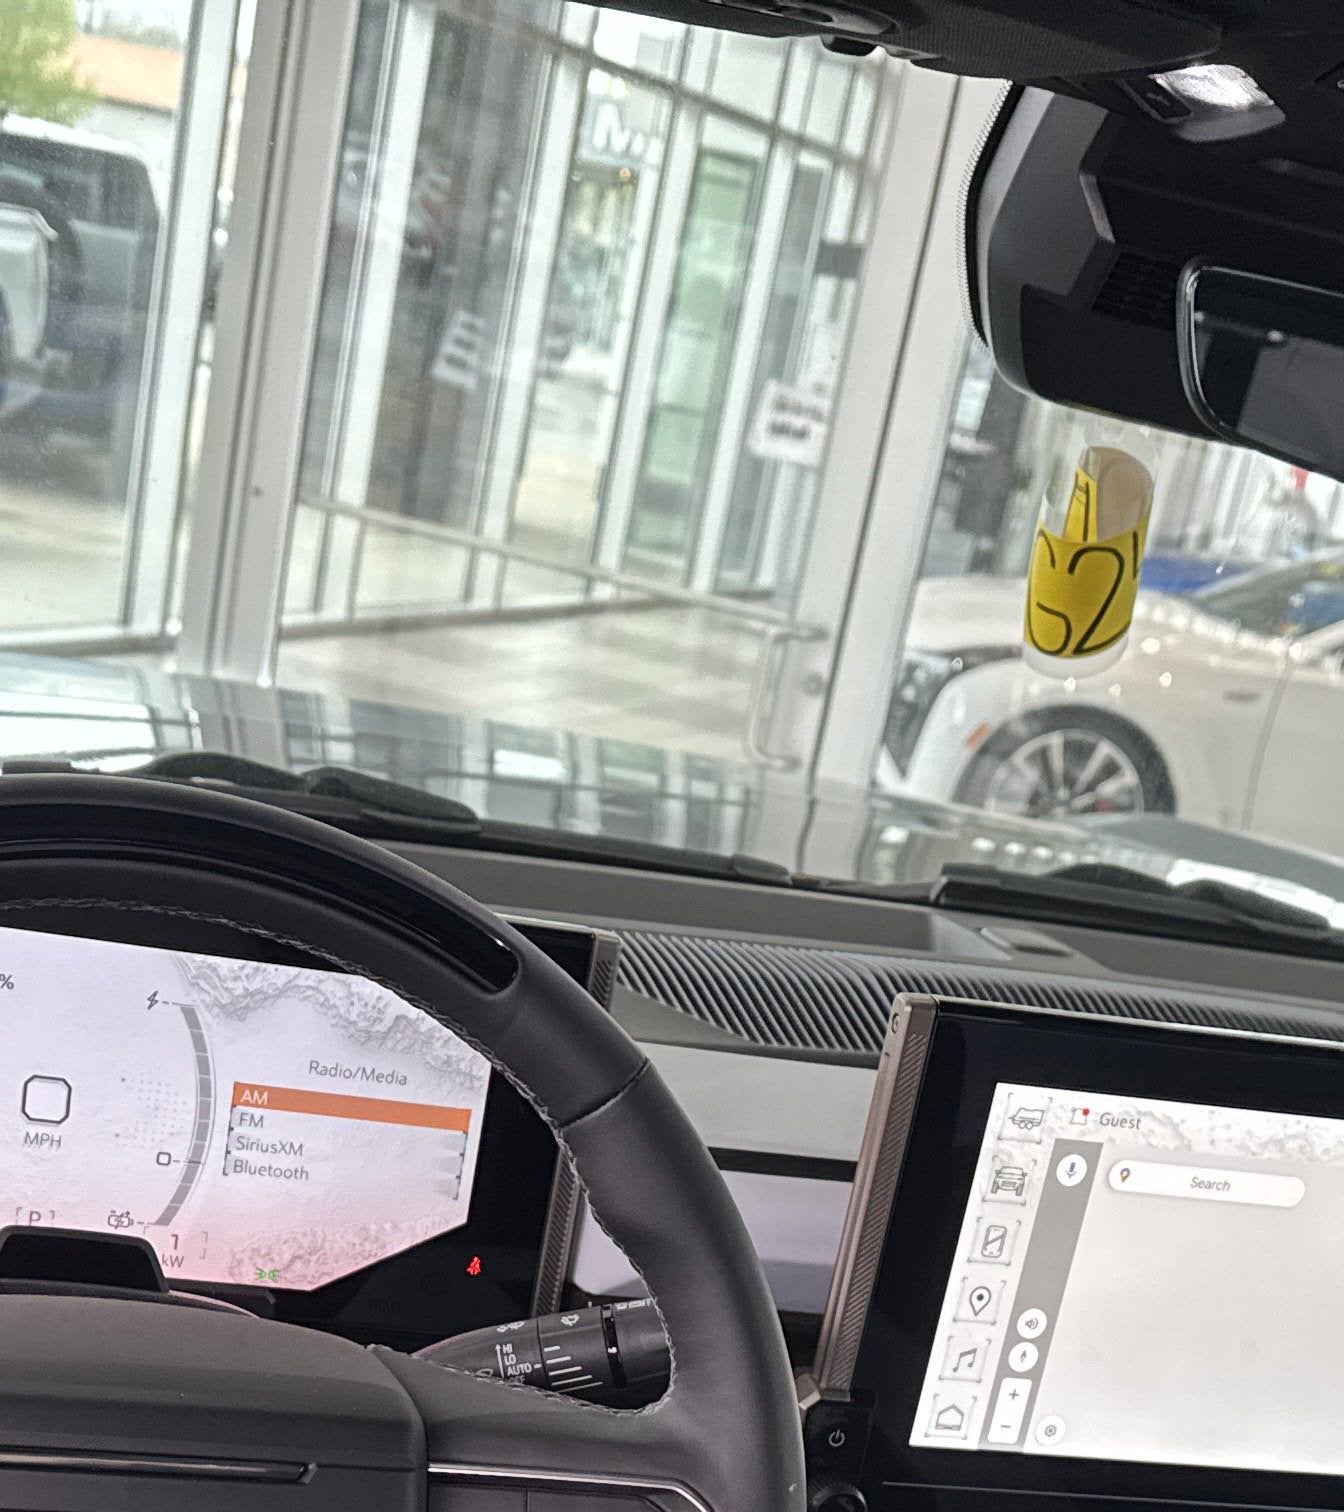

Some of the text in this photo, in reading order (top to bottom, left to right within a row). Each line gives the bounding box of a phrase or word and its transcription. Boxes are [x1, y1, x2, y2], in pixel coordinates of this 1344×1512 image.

[308, 1059, 408, 1087] Radio/Media
[239, 1088, 269, 1106] AM
[238, 1111, 264, 1129] FM
[1098, 1112, 1142, 1131] Guest
[23, 1131, 63, 1149] MPH
[235, 1135, 305, 1157] SiriusXM
[232, 1159, 310, 1182] Bluetooth
[1189, 1175, 1231, 1192] Search
[28, 1210, 42, 1226] P
[169, 1233, 180, 1250] 1
[161, 1254, 185, 1268] kW
[504, 1353, 517, 1366] LO
[506, 1362, 534, 1377] AUTO
